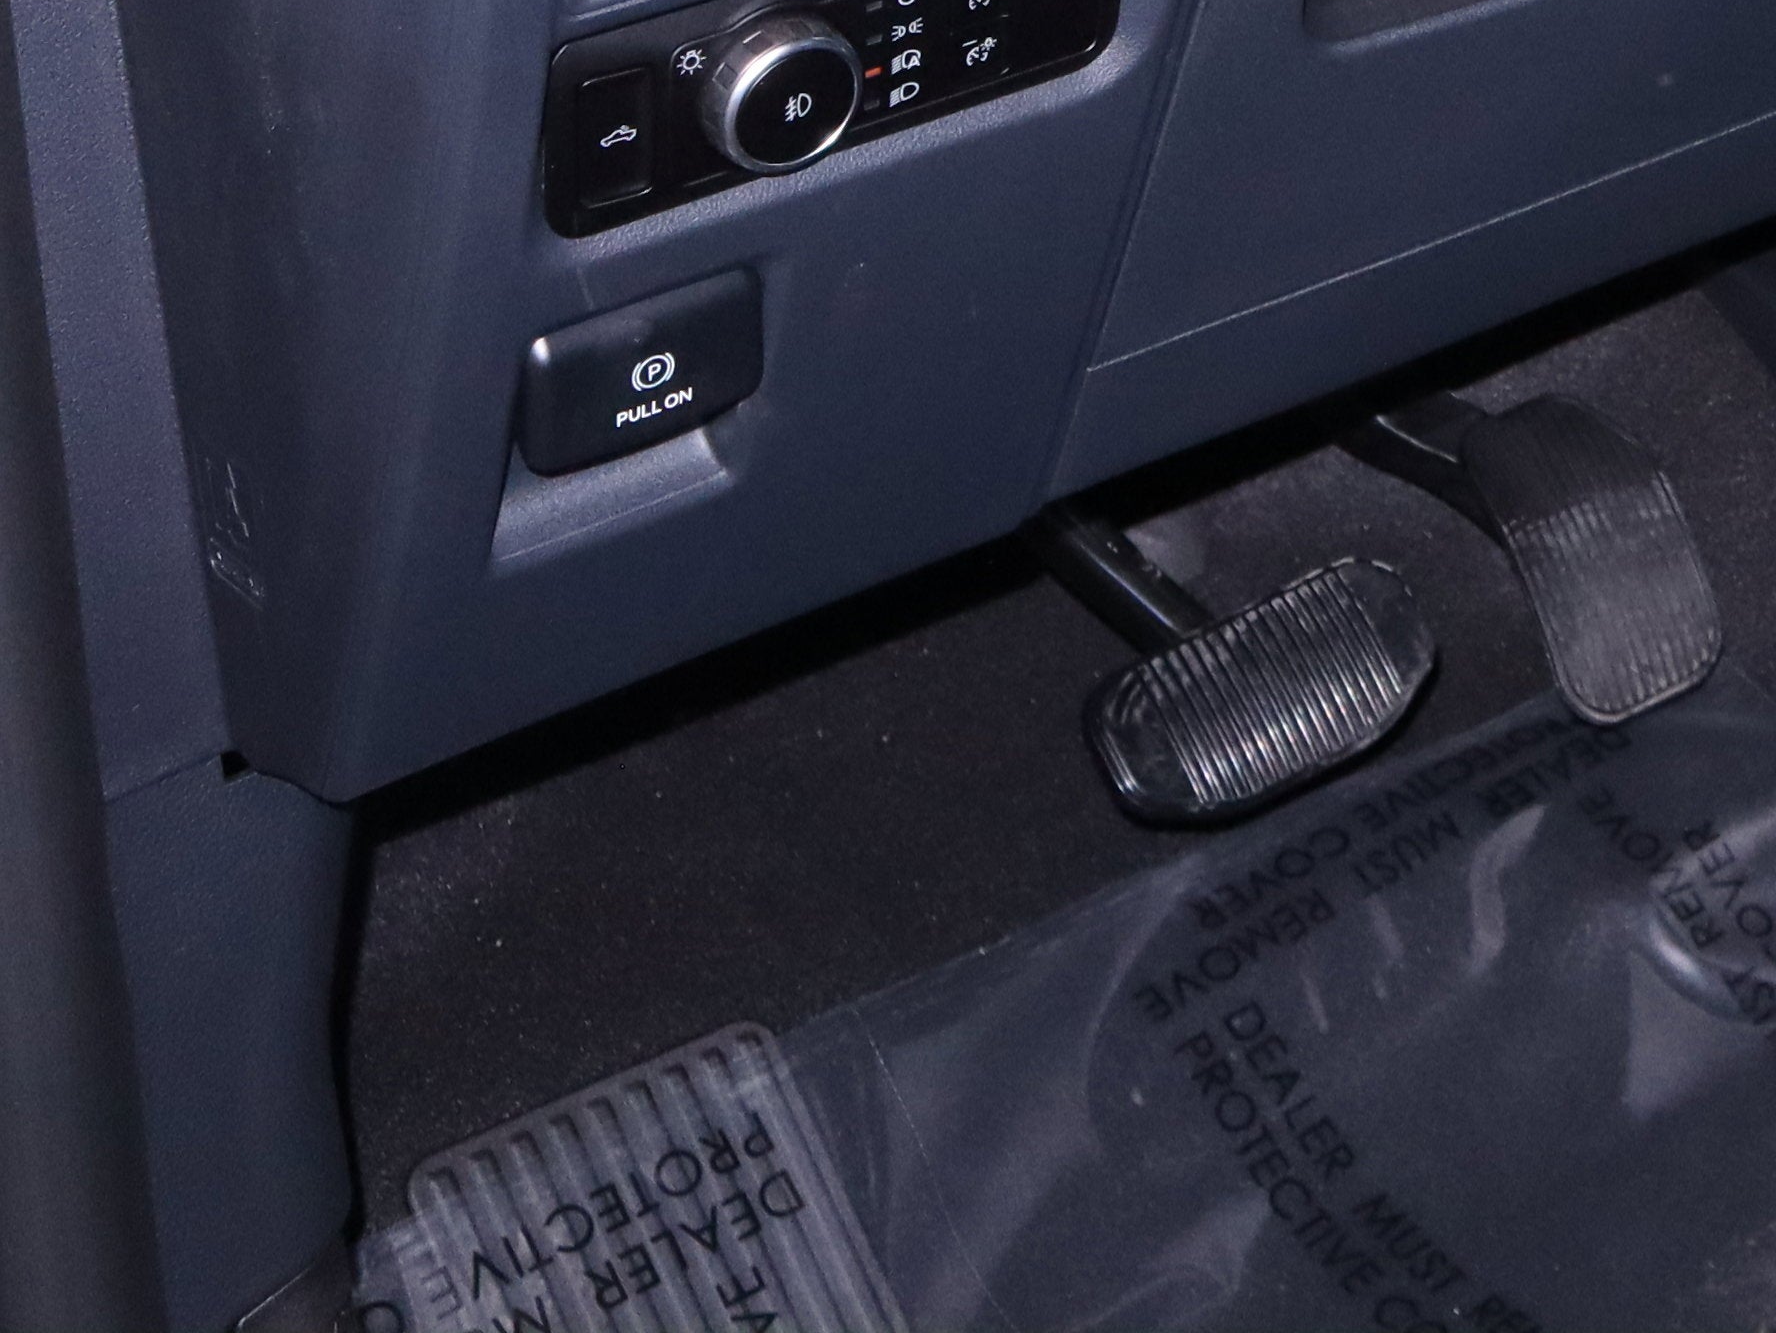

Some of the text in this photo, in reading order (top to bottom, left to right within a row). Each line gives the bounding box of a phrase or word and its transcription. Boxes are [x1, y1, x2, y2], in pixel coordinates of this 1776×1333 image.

[616, 386, 694, 428] PULL ON
[1190, 825, 1352, 931] COVER
[1133, 885, 1337, 1024] REMOVE
[1171, 1029, 1387, 1297] PROTECTIVE
[1222, 1000, 1356, 1181] DEALER
[1351, 1190, 1468, 1295] MUST
[584, 1168, 806, 1311] DEALER
